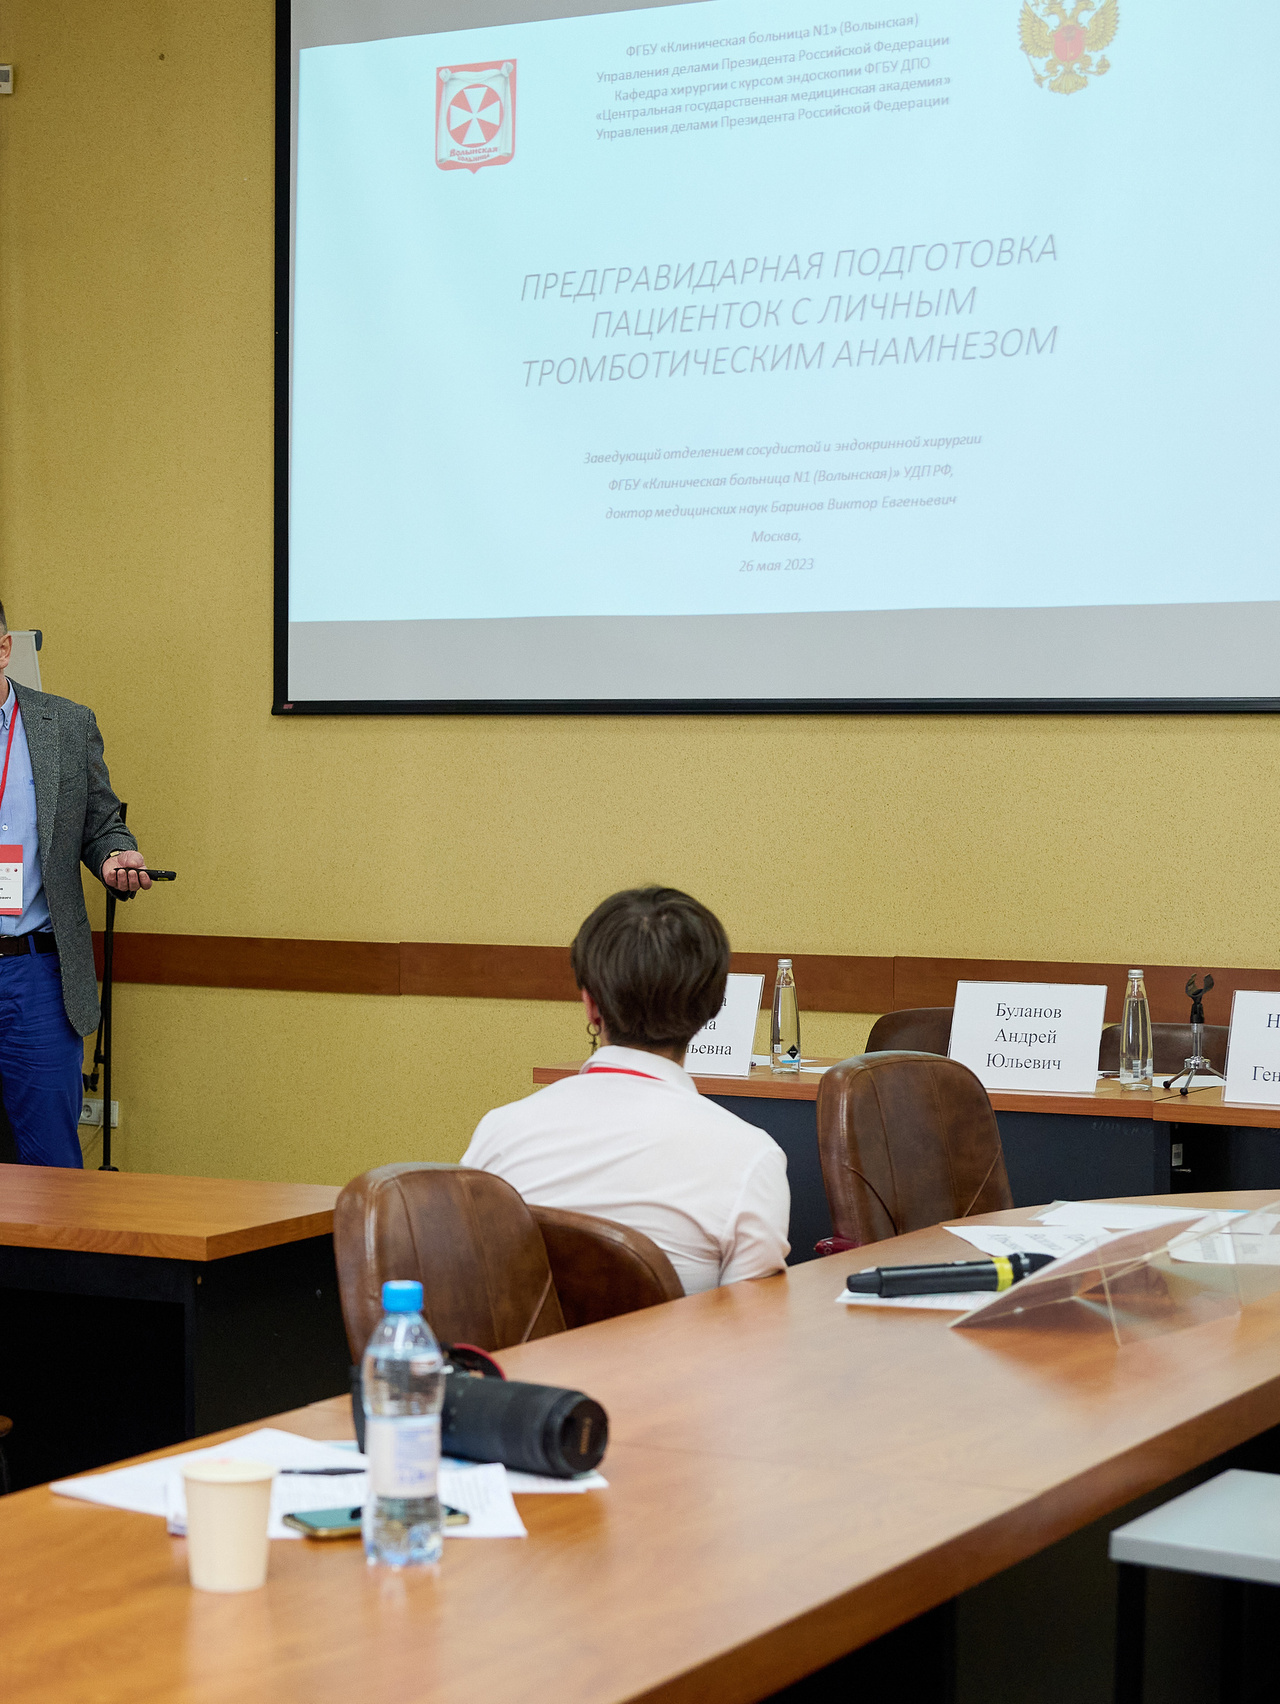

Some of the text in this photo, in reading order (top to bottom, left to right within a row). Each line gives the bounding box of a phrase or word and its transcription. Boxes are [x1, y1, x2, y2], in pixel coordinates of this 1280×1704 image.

[626, 13, 919, 57] ФГБУ «Клиническая больница N1» (Волынская)
[597, 37, 950, 84] Управления делами Президента Российской Федерации
[615, 57, 930, 102] Кафедра хирургии с курсом эндоскопии ФГБУ ДПО
[596, 77, 951, 122] «Центральная государственная медицинская академия»
[596, 97, 950, 141] Управления делами Президента Российской Федерации
[521, 233, 1057, 303] ПРЕДГРАВИДАРНАЯ ПОДГОТОВКА
[592, 286, 977, 341] ПАЦИЕНТОК С ЛИЧНЫМ
[523, 325, 1058, 387] ТРОМБОТИЧЕСКИМ АНАМНЕЗОМ
[584, 434, 982, 465] Заведующий отделением сосудистой и эндокринной хирургии
[606, 496, 957, 520] доктор медицинских наук Баринов Виктор Евгеньевич
[751, 531, 801, 542] Москва,
[739, 558, 814, 572] 26 мая 2023
[996, 1002, 1062, 1021] Буланов
[995, 1028, 1057, 1047] Андрей
[986, 1053, 1062, 1070] Юльевич
